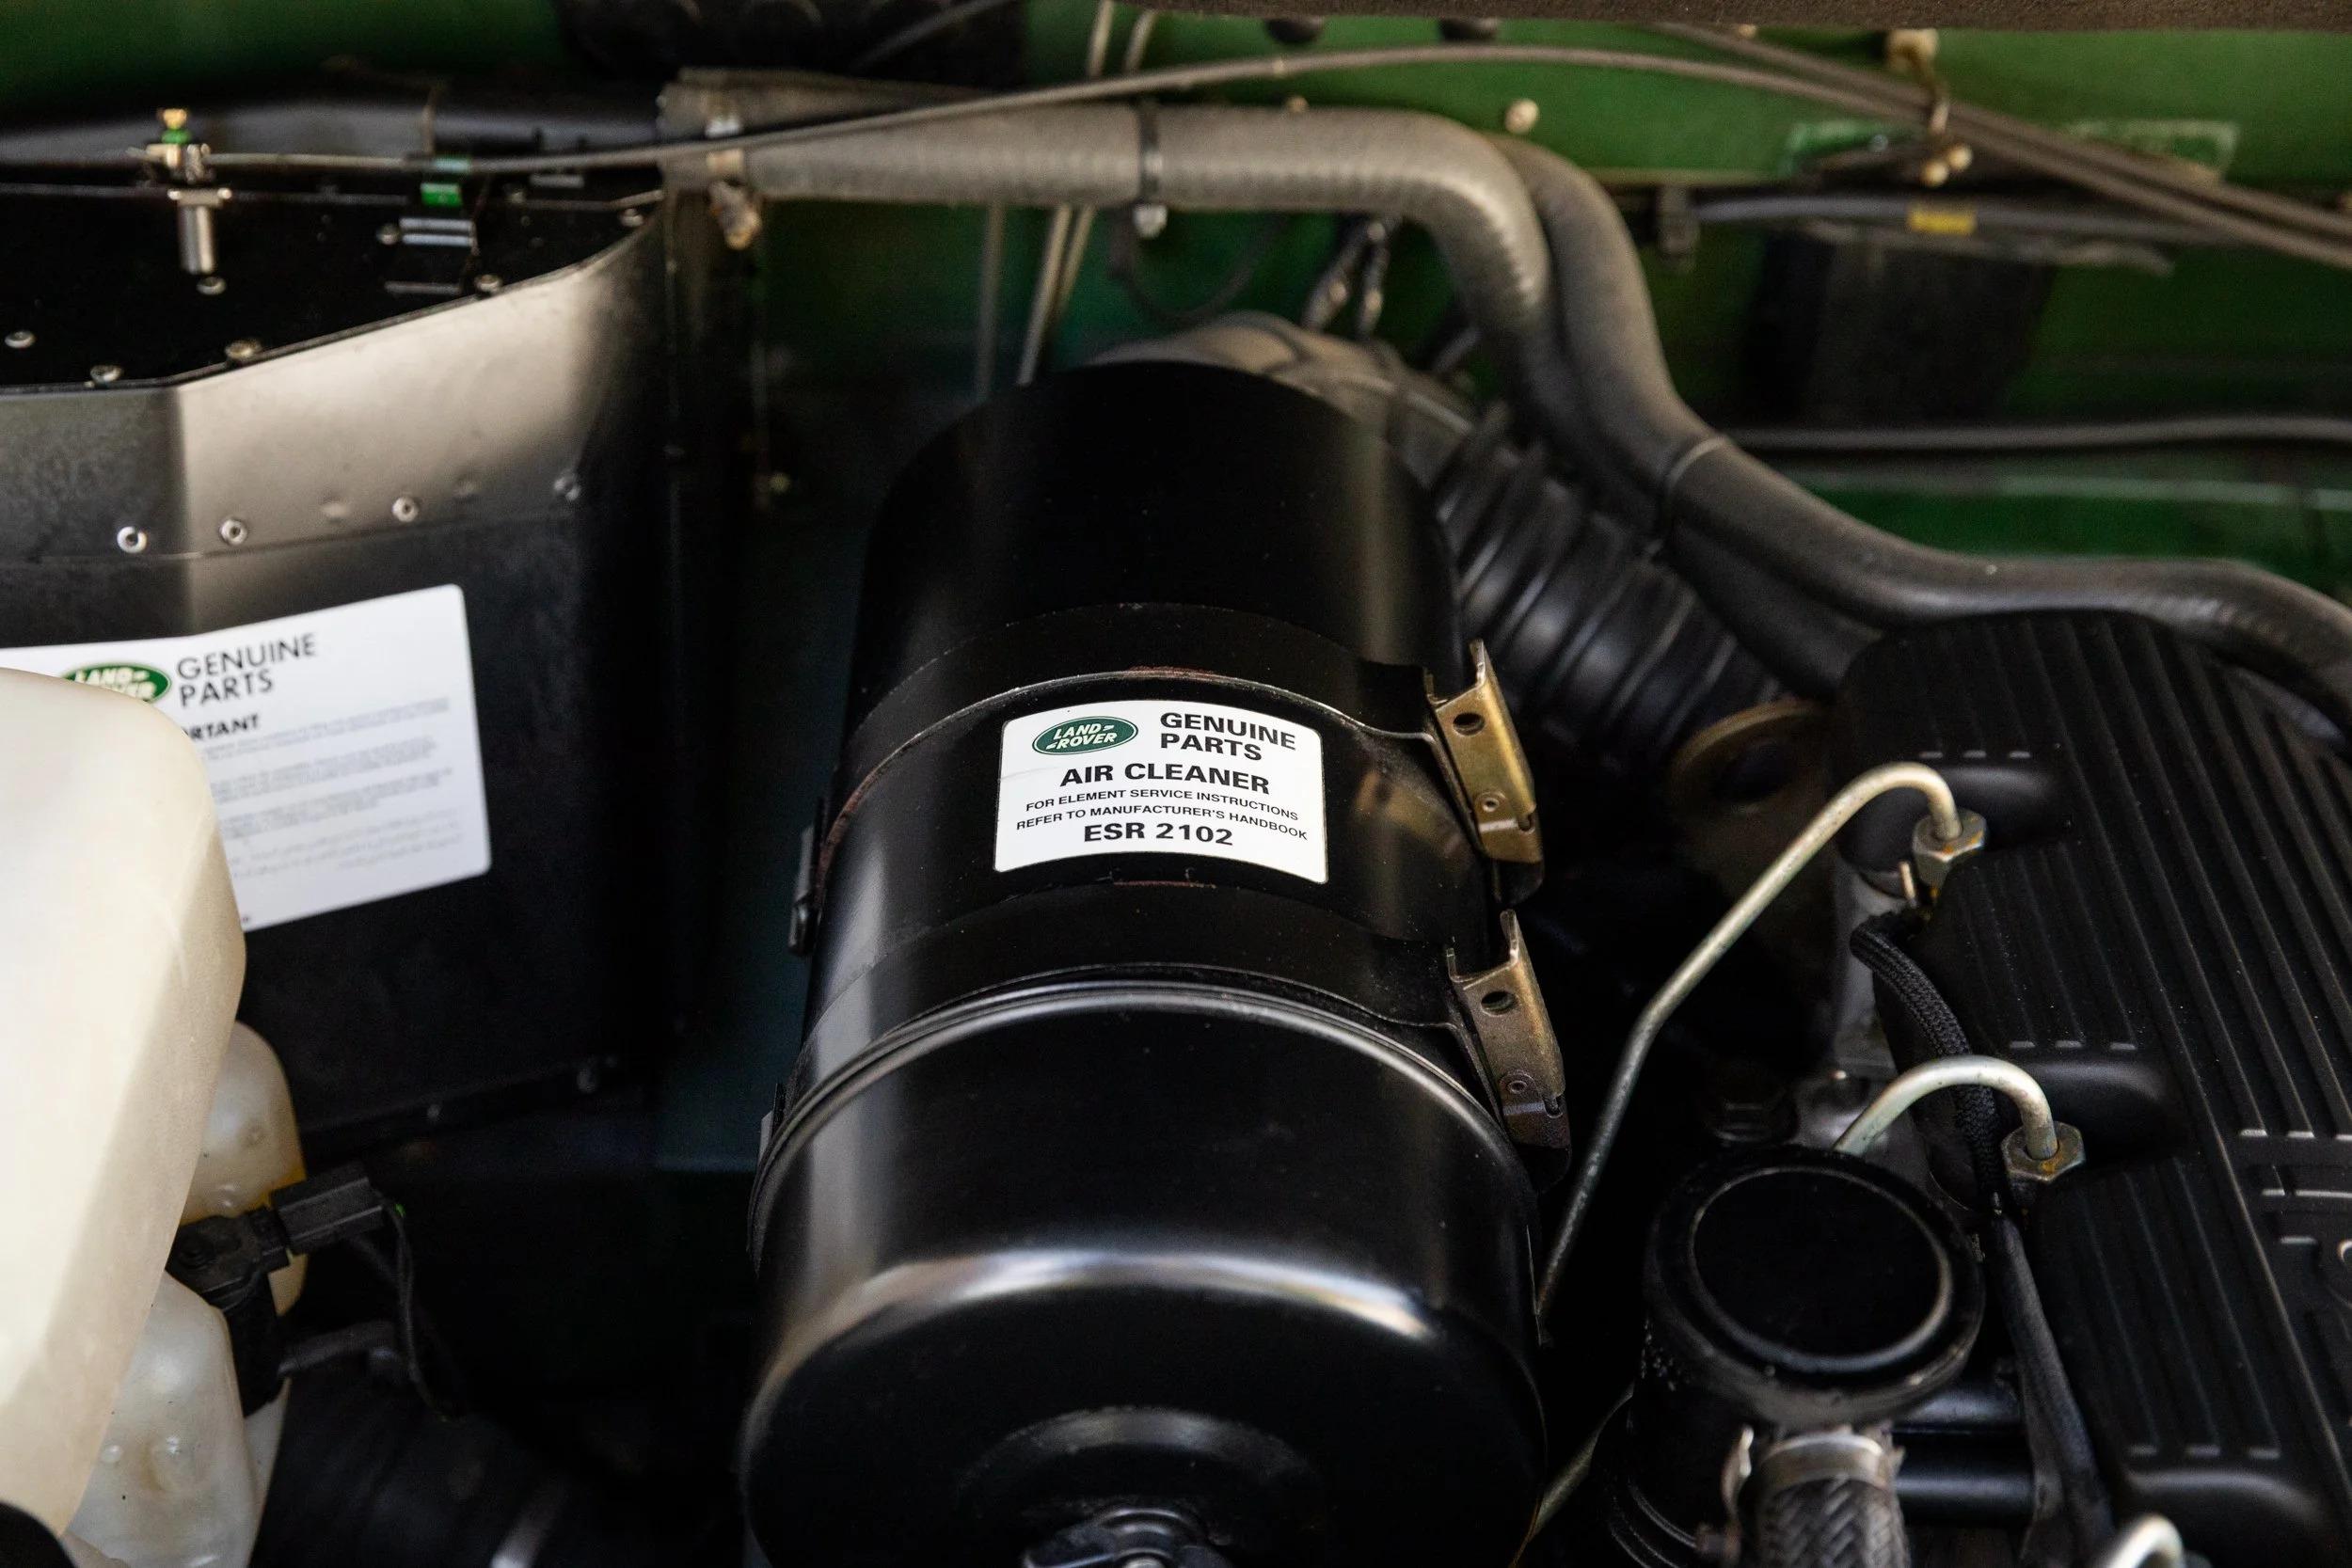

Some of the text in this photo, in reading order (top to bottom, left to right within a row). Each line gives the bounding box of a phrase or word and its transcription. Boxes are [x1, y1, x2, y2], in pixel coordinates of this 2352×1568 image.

[177, 633, 317, 682] GENUINE
[179, 669, 274, 707] PARTS
[182, 713, 259, 739] RTANT
[1053, 725, 1100, 739] LAND
[1056, 732, 1117, 749] ROVER
[1160, 712, 1296, 751] GENUINE
[1160, 733, 1263, 761] PARTS
[1059, 763, 1270, 795] AIR CLEANER
[1025, 789, 1299, 821] FOR ELEMENT SERVICE INSTRUCTIONS
[1016, 805, 1308, 840] REFER TO MANUFACTURER'S HANDBOOK
[1084, 822, 1233, 846] ESR 2102
